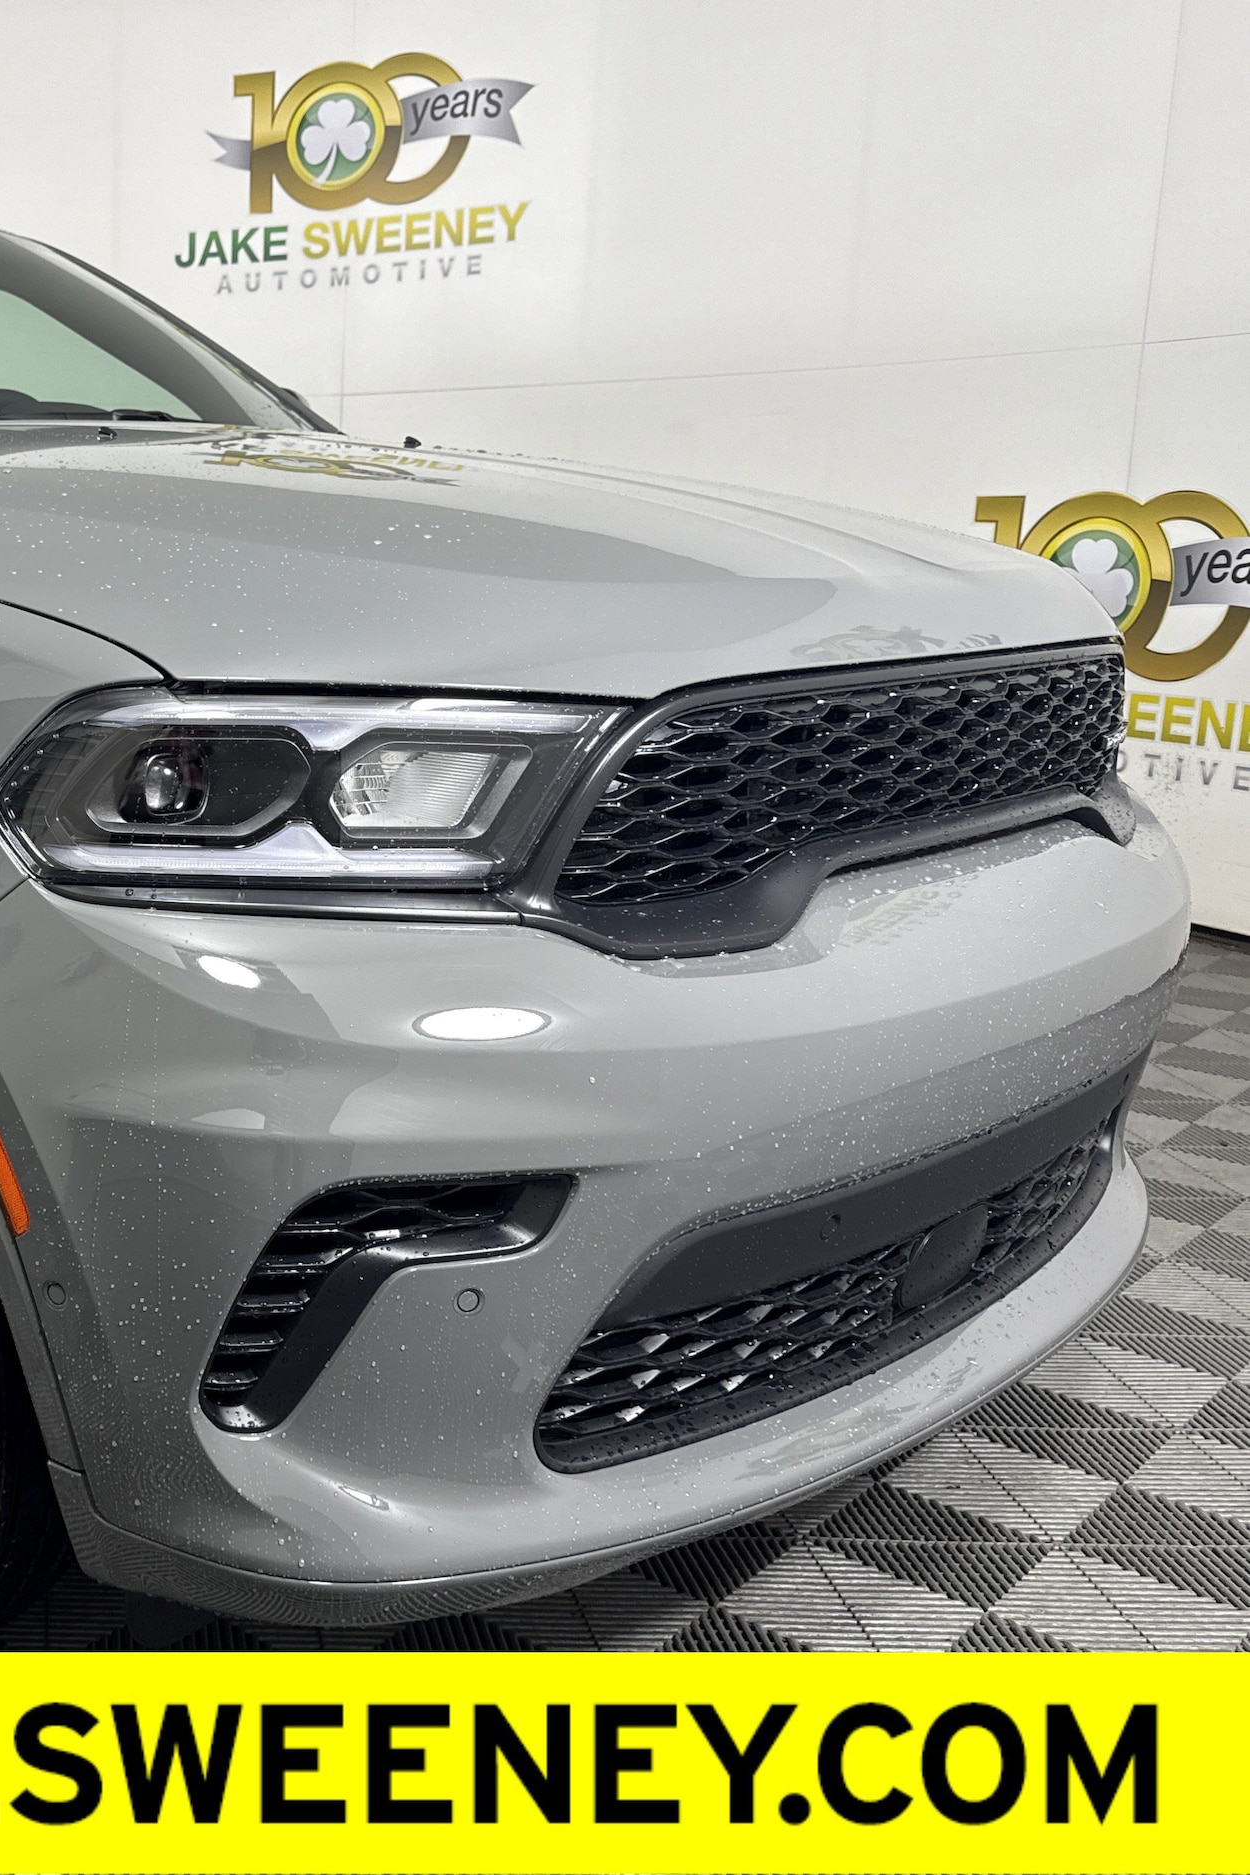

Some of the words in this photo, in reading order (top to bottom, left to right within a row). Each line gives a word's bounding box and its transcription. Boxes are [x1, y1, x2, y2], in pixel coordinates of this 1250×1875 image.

[233, 52, 471, 214] 100
[410, 86, 504, 136] years
[175, 226, 288, 268] JAKE
[302, 201, 530, 260] SWEENEY
[216, 255, 483, 295] AUTOMOTIVE
